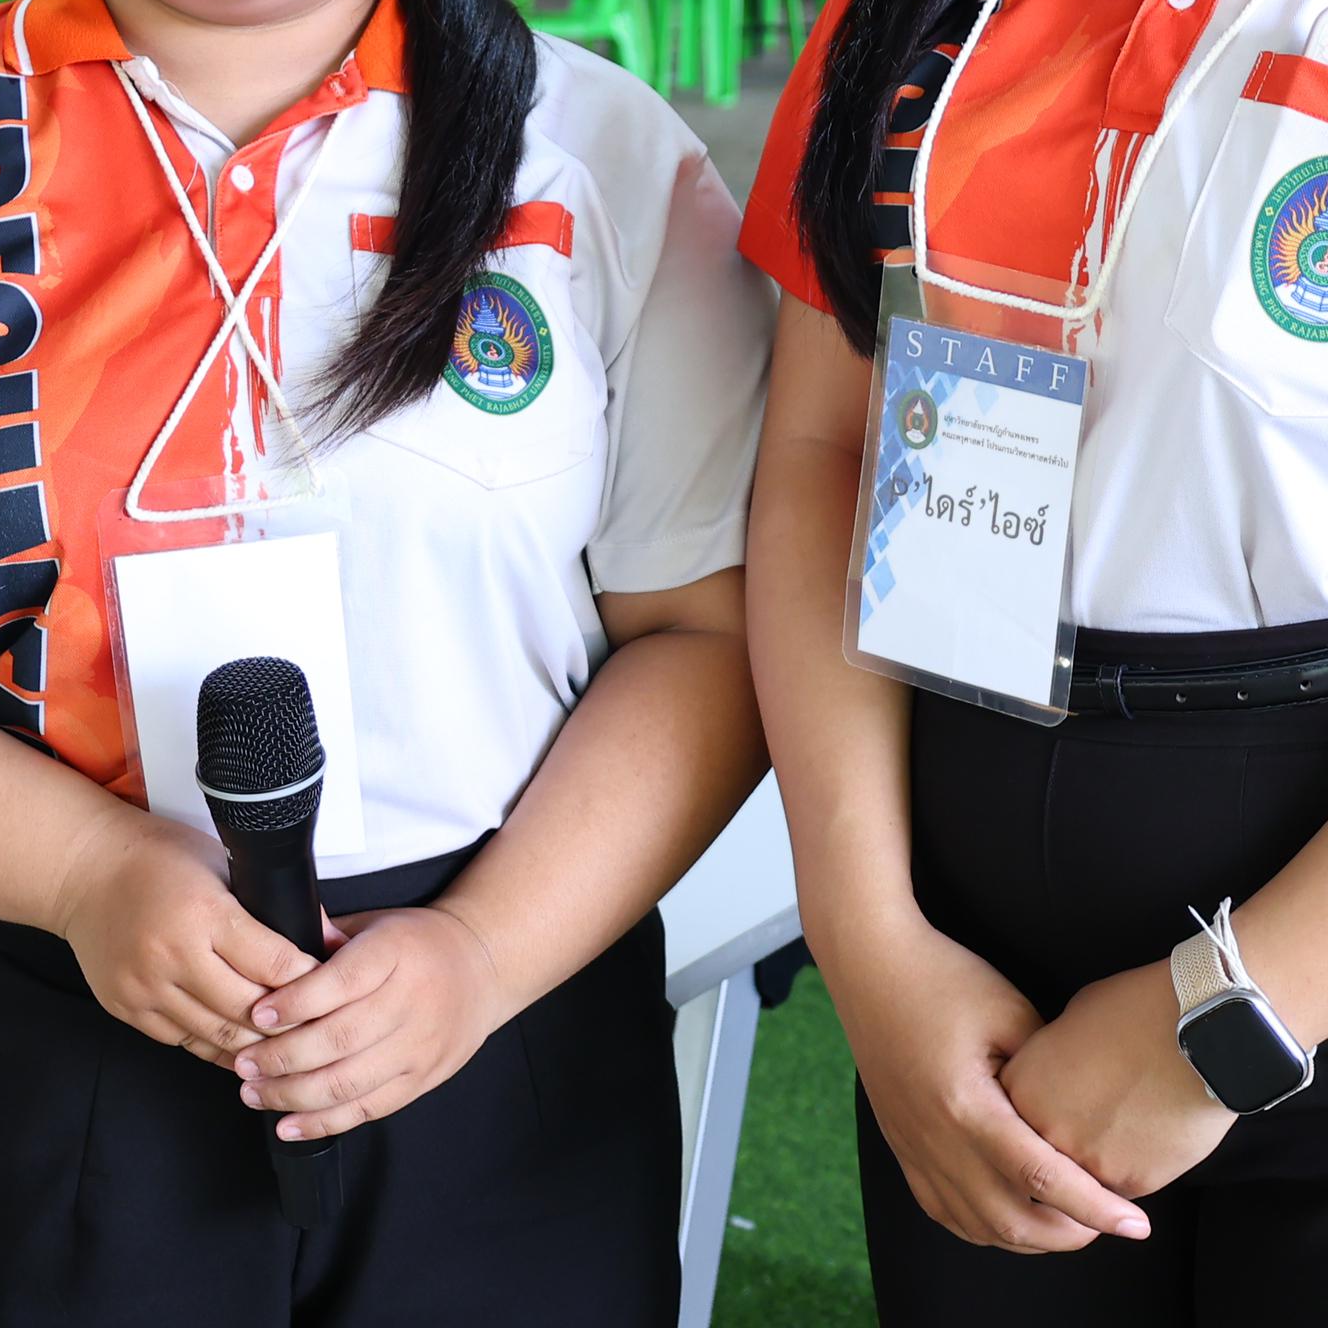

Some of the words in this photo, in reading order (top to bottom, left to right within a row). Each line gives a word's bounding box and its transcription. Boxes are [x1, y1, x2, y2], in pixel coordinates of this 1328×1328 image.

[1256, 224, 1271, 296] KAMPHAENG
[1266, 298, 1287, 325] PHET
[905, 329, 1070, 392] STAFF
[460, 386, 484, 407] PHET
[486, 395, 531, 414] RAJABHAT
